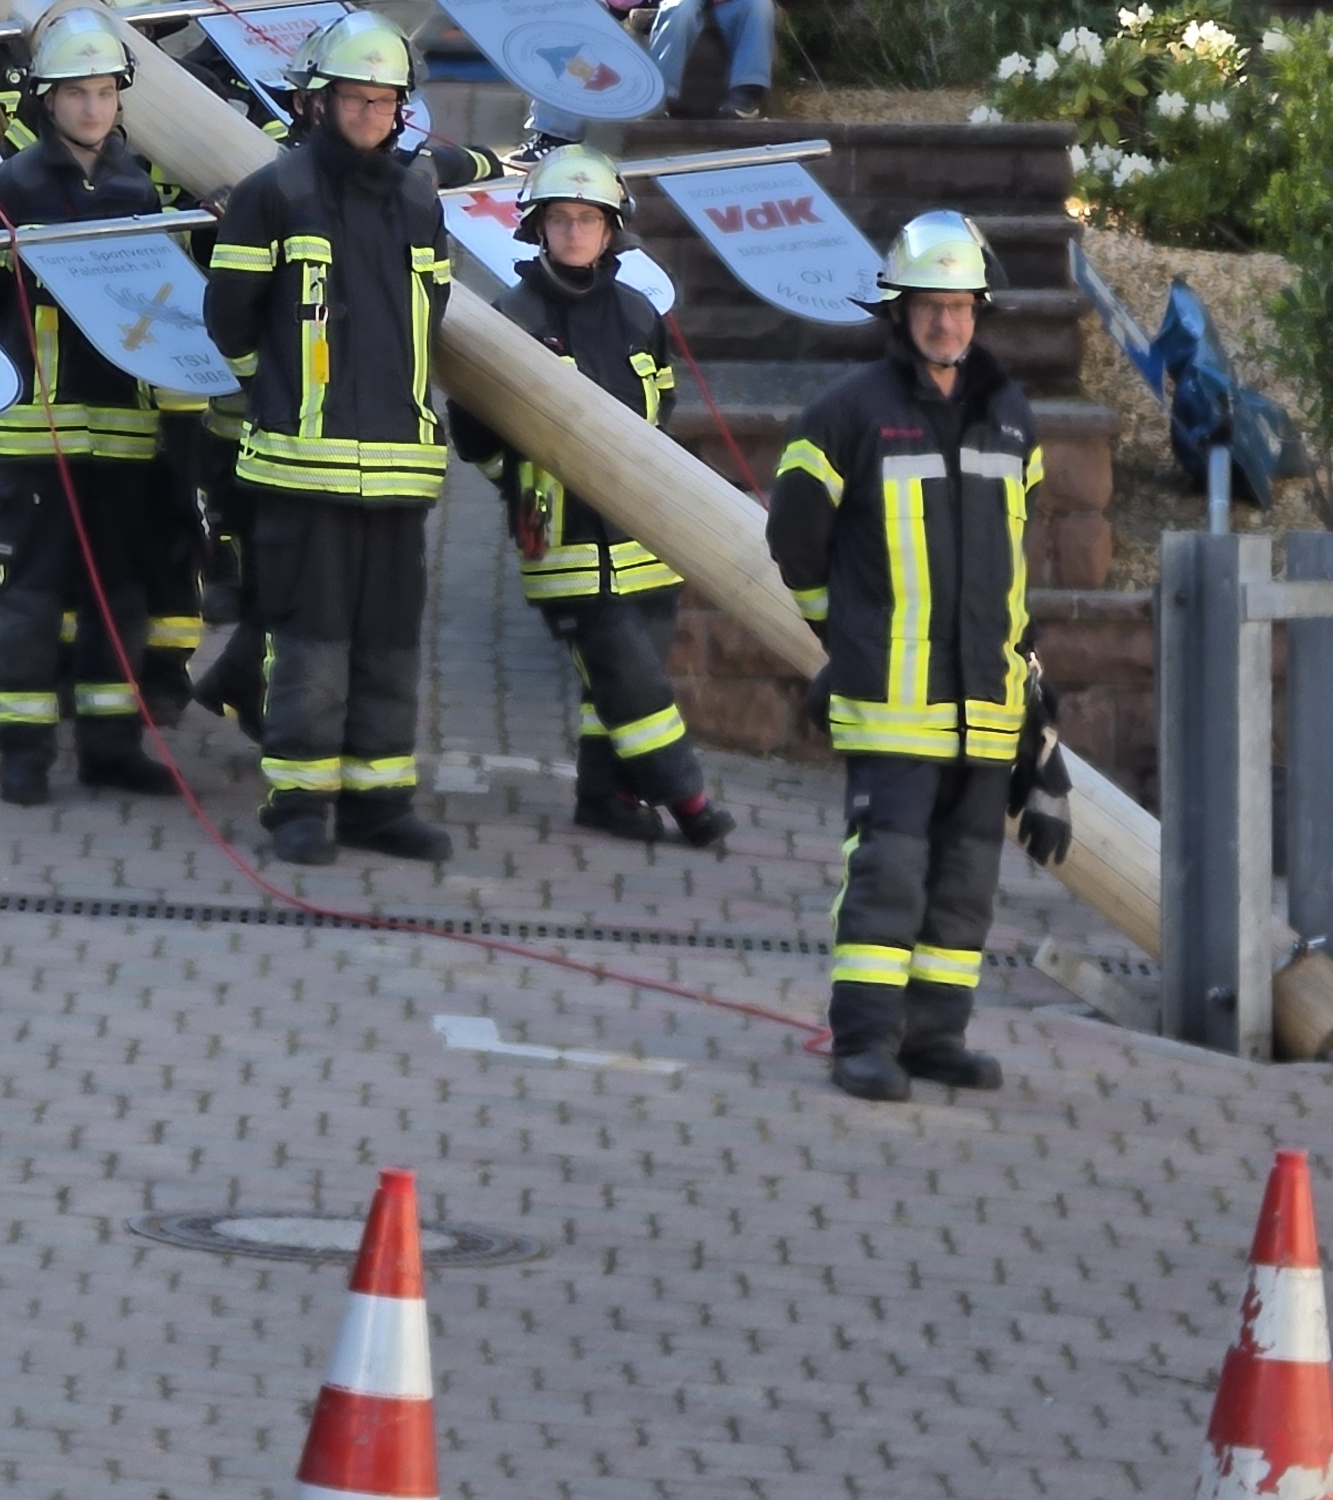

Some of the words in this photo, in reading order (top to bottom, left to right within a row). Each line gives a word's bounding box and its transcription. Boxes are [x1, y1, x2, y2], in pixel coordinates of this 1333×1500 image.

[688, 178, 804, 200] SOZIALVERBAND
[703, 195, 827, 234] VdK
[89, 244, 174, 263] Sportverein
[68, 260, 139, 279] Palmbach
[142, 258, 167, 272] e.V.
[799, 268, 834, 286] OV
[775, 267, 874, 311] Wetterbach
[170, 352, 212, 368] TSV
[184, 369, 232, 385] 1905
